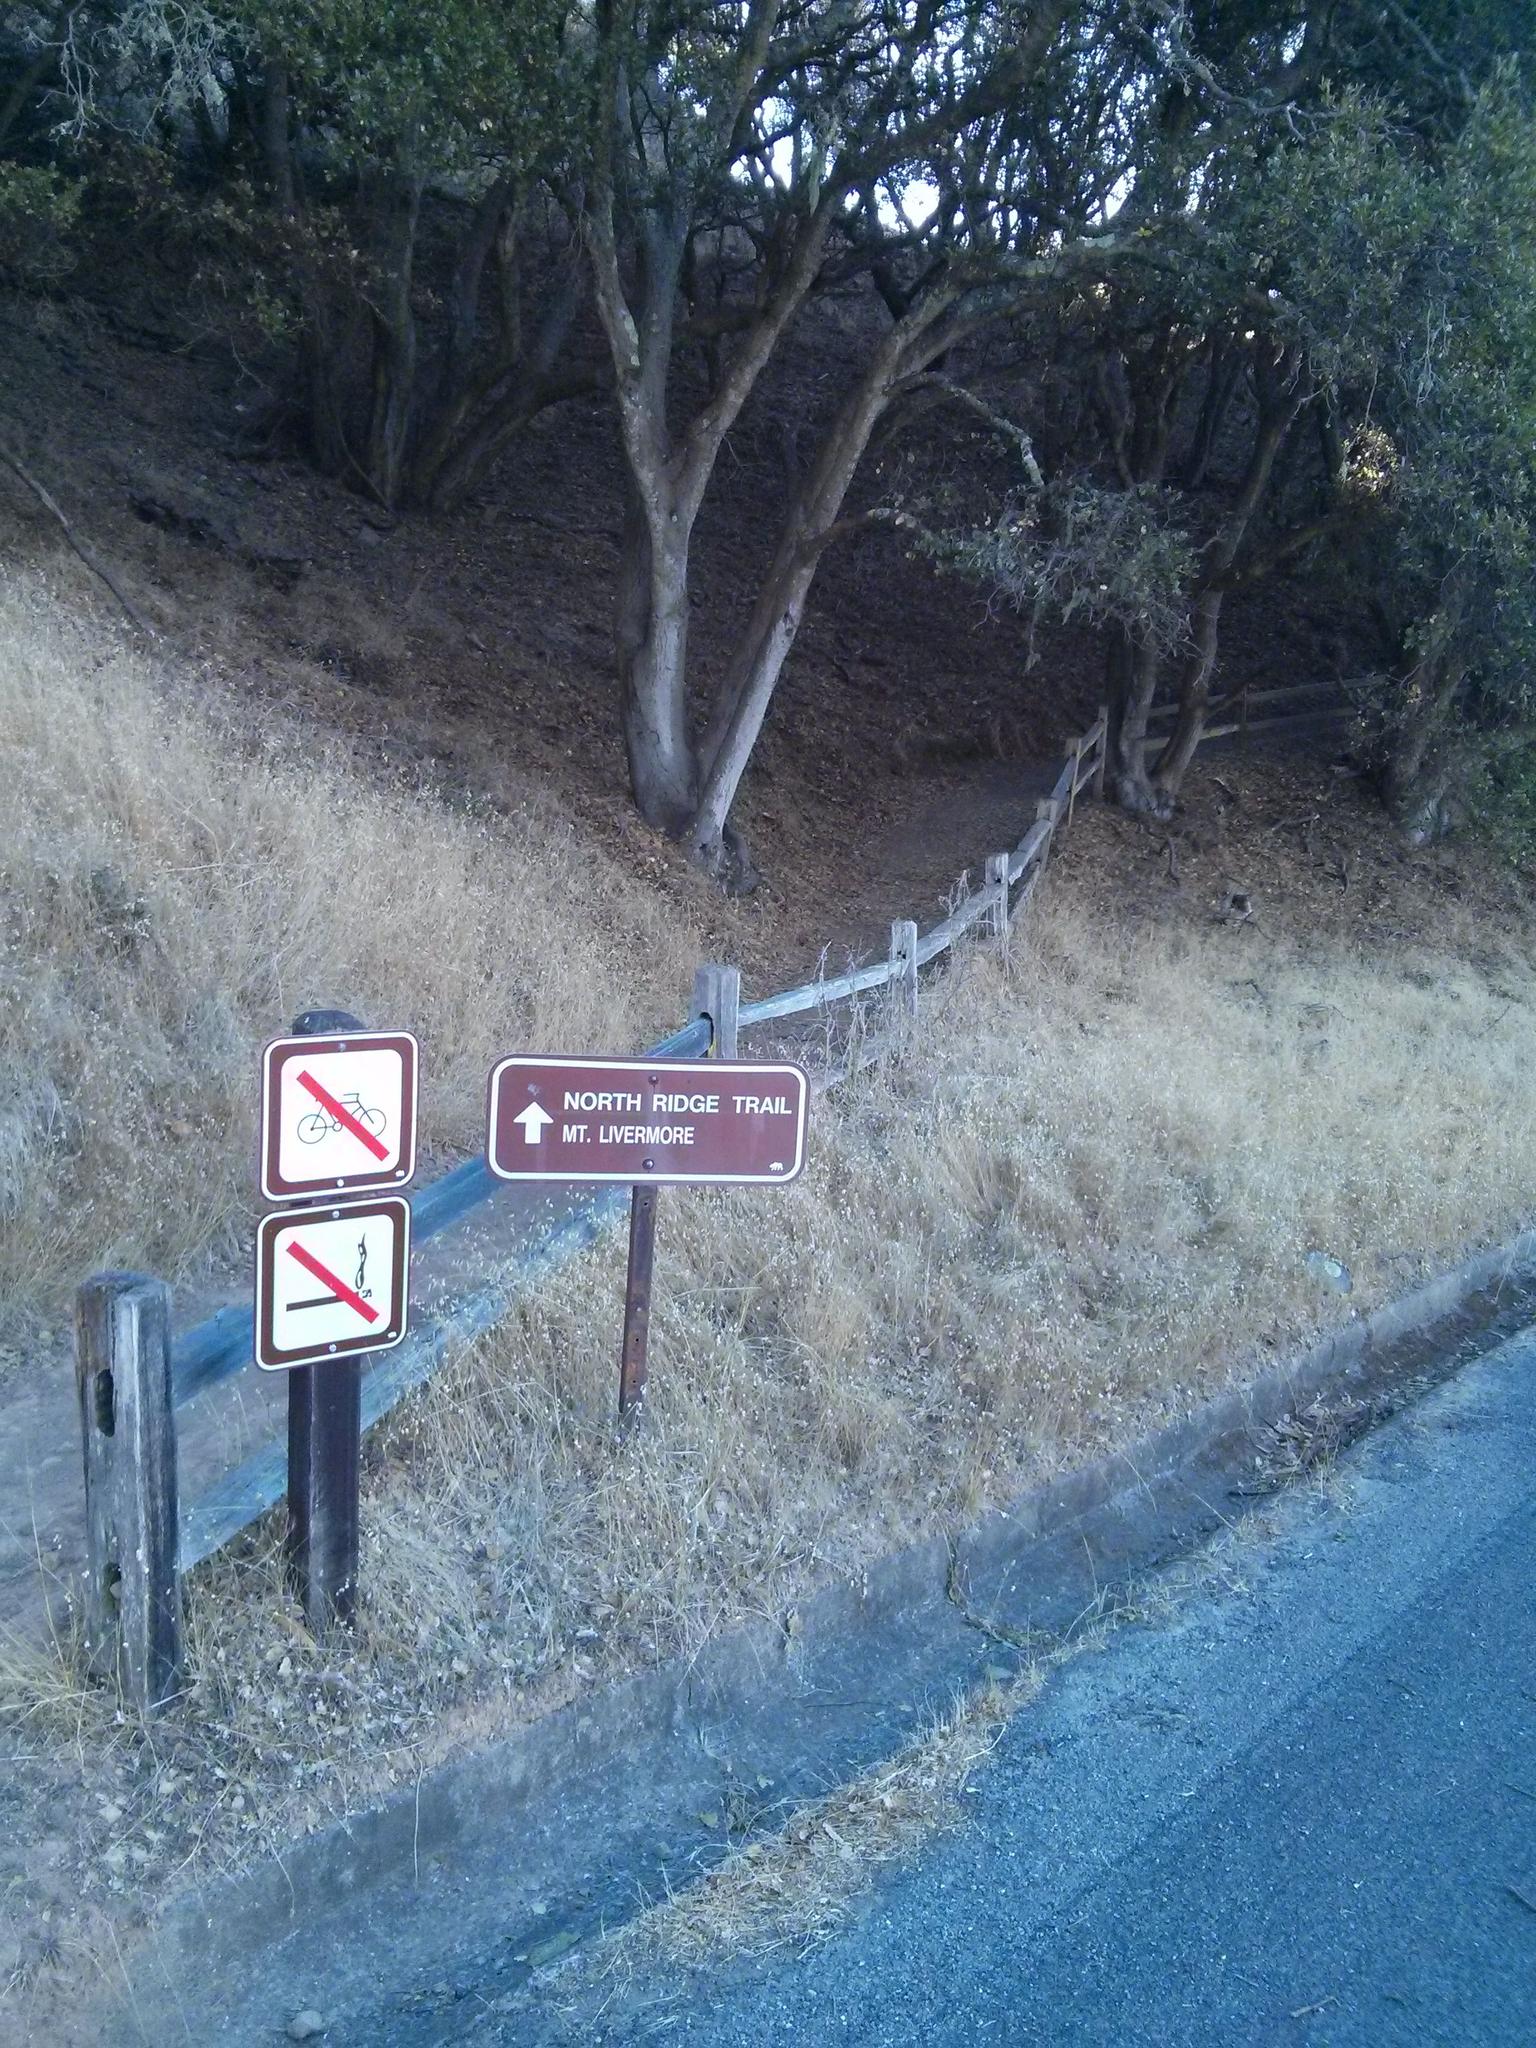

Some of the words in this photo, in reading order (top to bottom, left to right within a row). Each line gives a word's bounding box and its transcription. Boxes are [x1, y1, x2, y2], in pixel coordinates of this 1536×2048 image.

[563, 1091, 642, 1112] NORTH
[652, 1093, 719, 1114] RIDGE
[732, 1095, 792, 1115] TRAIL
[562, 1124, 591, 1144] MT.
[599, 1125, 695, 1145] LIVERMORE
